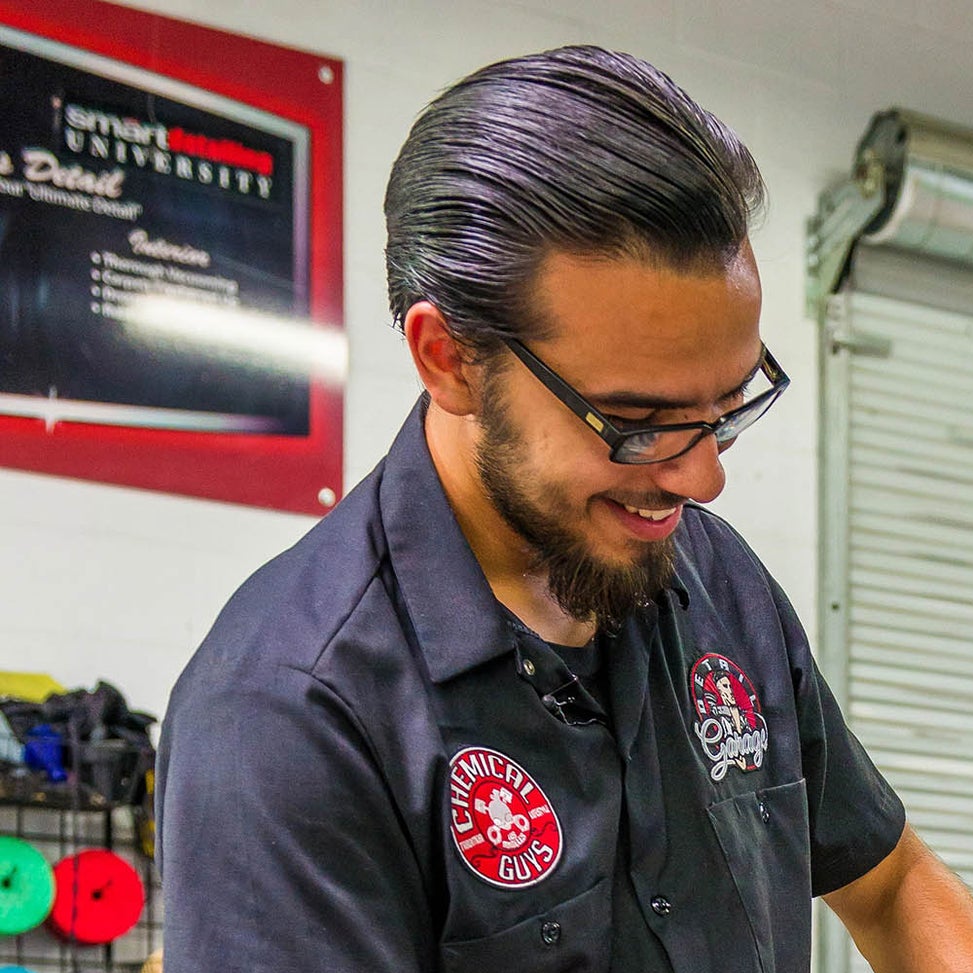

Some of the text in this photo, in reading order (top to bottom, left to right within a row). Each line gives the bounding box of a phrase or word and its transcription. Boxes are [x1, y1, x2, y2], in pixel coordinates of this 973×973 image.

[65, 126, 273, 199] UNIVERSITY
[450, 753, 535, 834] CHEMICAL
[498, 839, 554, 881] GUYS
